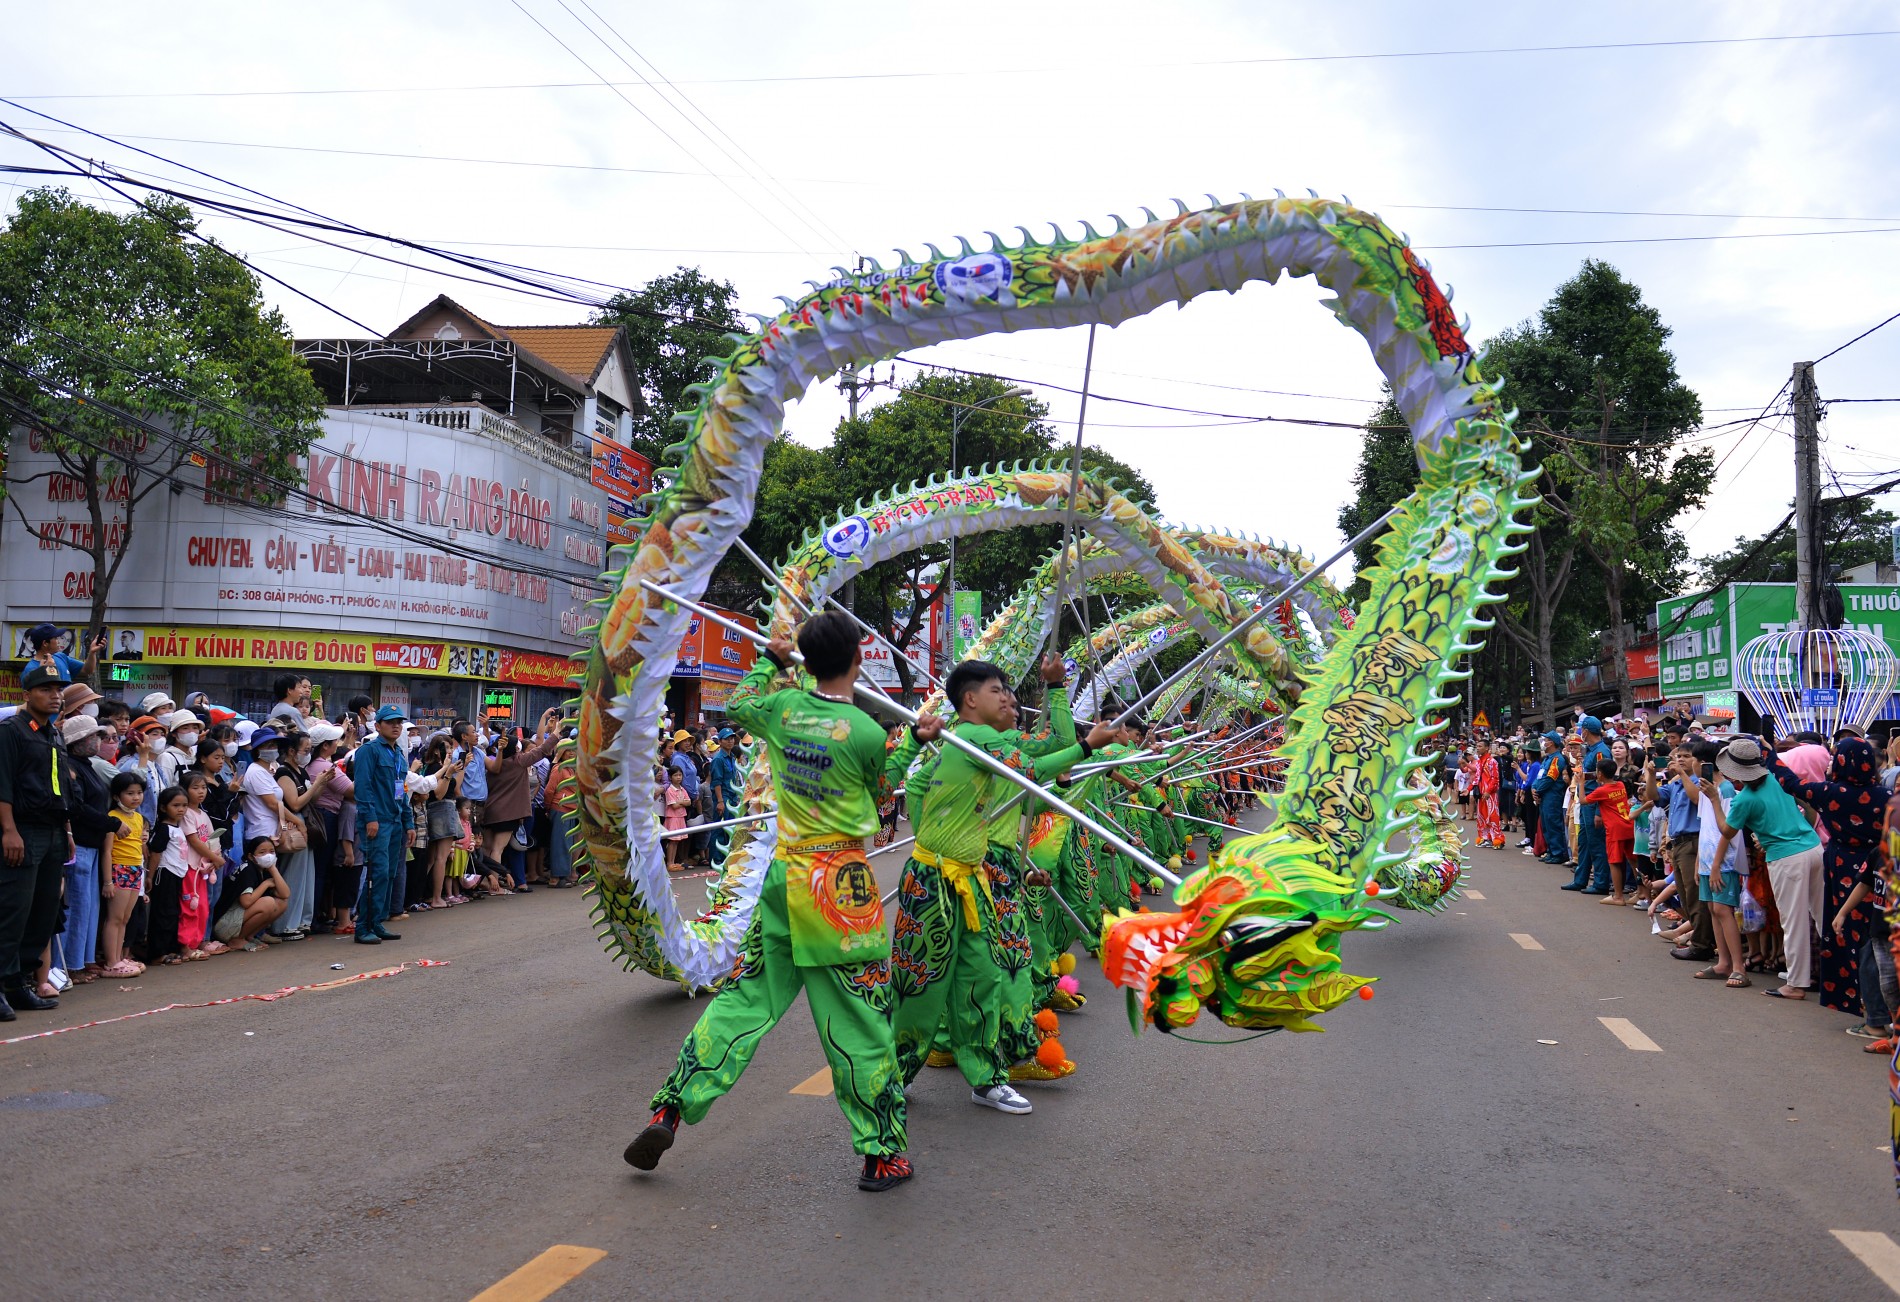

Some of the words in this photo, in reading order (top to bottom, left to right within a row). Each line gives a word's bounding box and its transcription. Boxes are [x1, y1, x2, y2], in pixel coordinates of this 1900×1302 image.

[305, 442, 406, 521] KÍNH
[417, 468, 504, 539] RẠNG
[505, 478, 551, 551] ĐÔNG
[931, 484, 997, 510] TRÂM
[39, 516, 65, 550] KỸ
[265, 535, 297, 575] CẬN
[311, 535, 346, 574] VIỄN
[357, 547, 395, 583] LOẠN
[404, 552, 428, 582] HAI
[218, 590, 239, 600] ĐC:
[242, 590, 262, 601] 308
[288, 591, 324, 604] PHÓNG
[347, 595, 381, 608] PHƯỚC
[383, 600, 397, 610] AN
[401, 602, 411, 611] H.
[412, 601, 441, 614] KRÔNG
[147, 630, 189, 657] MẮT
[195, 633, 245, 659] KÍNH
[251, 638, 308, 664] RẠNG
[313, 638, 367, 665] ĐÔNG
[375, 647, 399, 662] GIẢM
[398, 645, 437, 669] 20%
[864, 648, 888, 660] SÀI
[1665, 626, 1703, 662] THIÊN
[1707, 619, 1723, 655] LÝ
[421, 707, 435, 717] Tư
